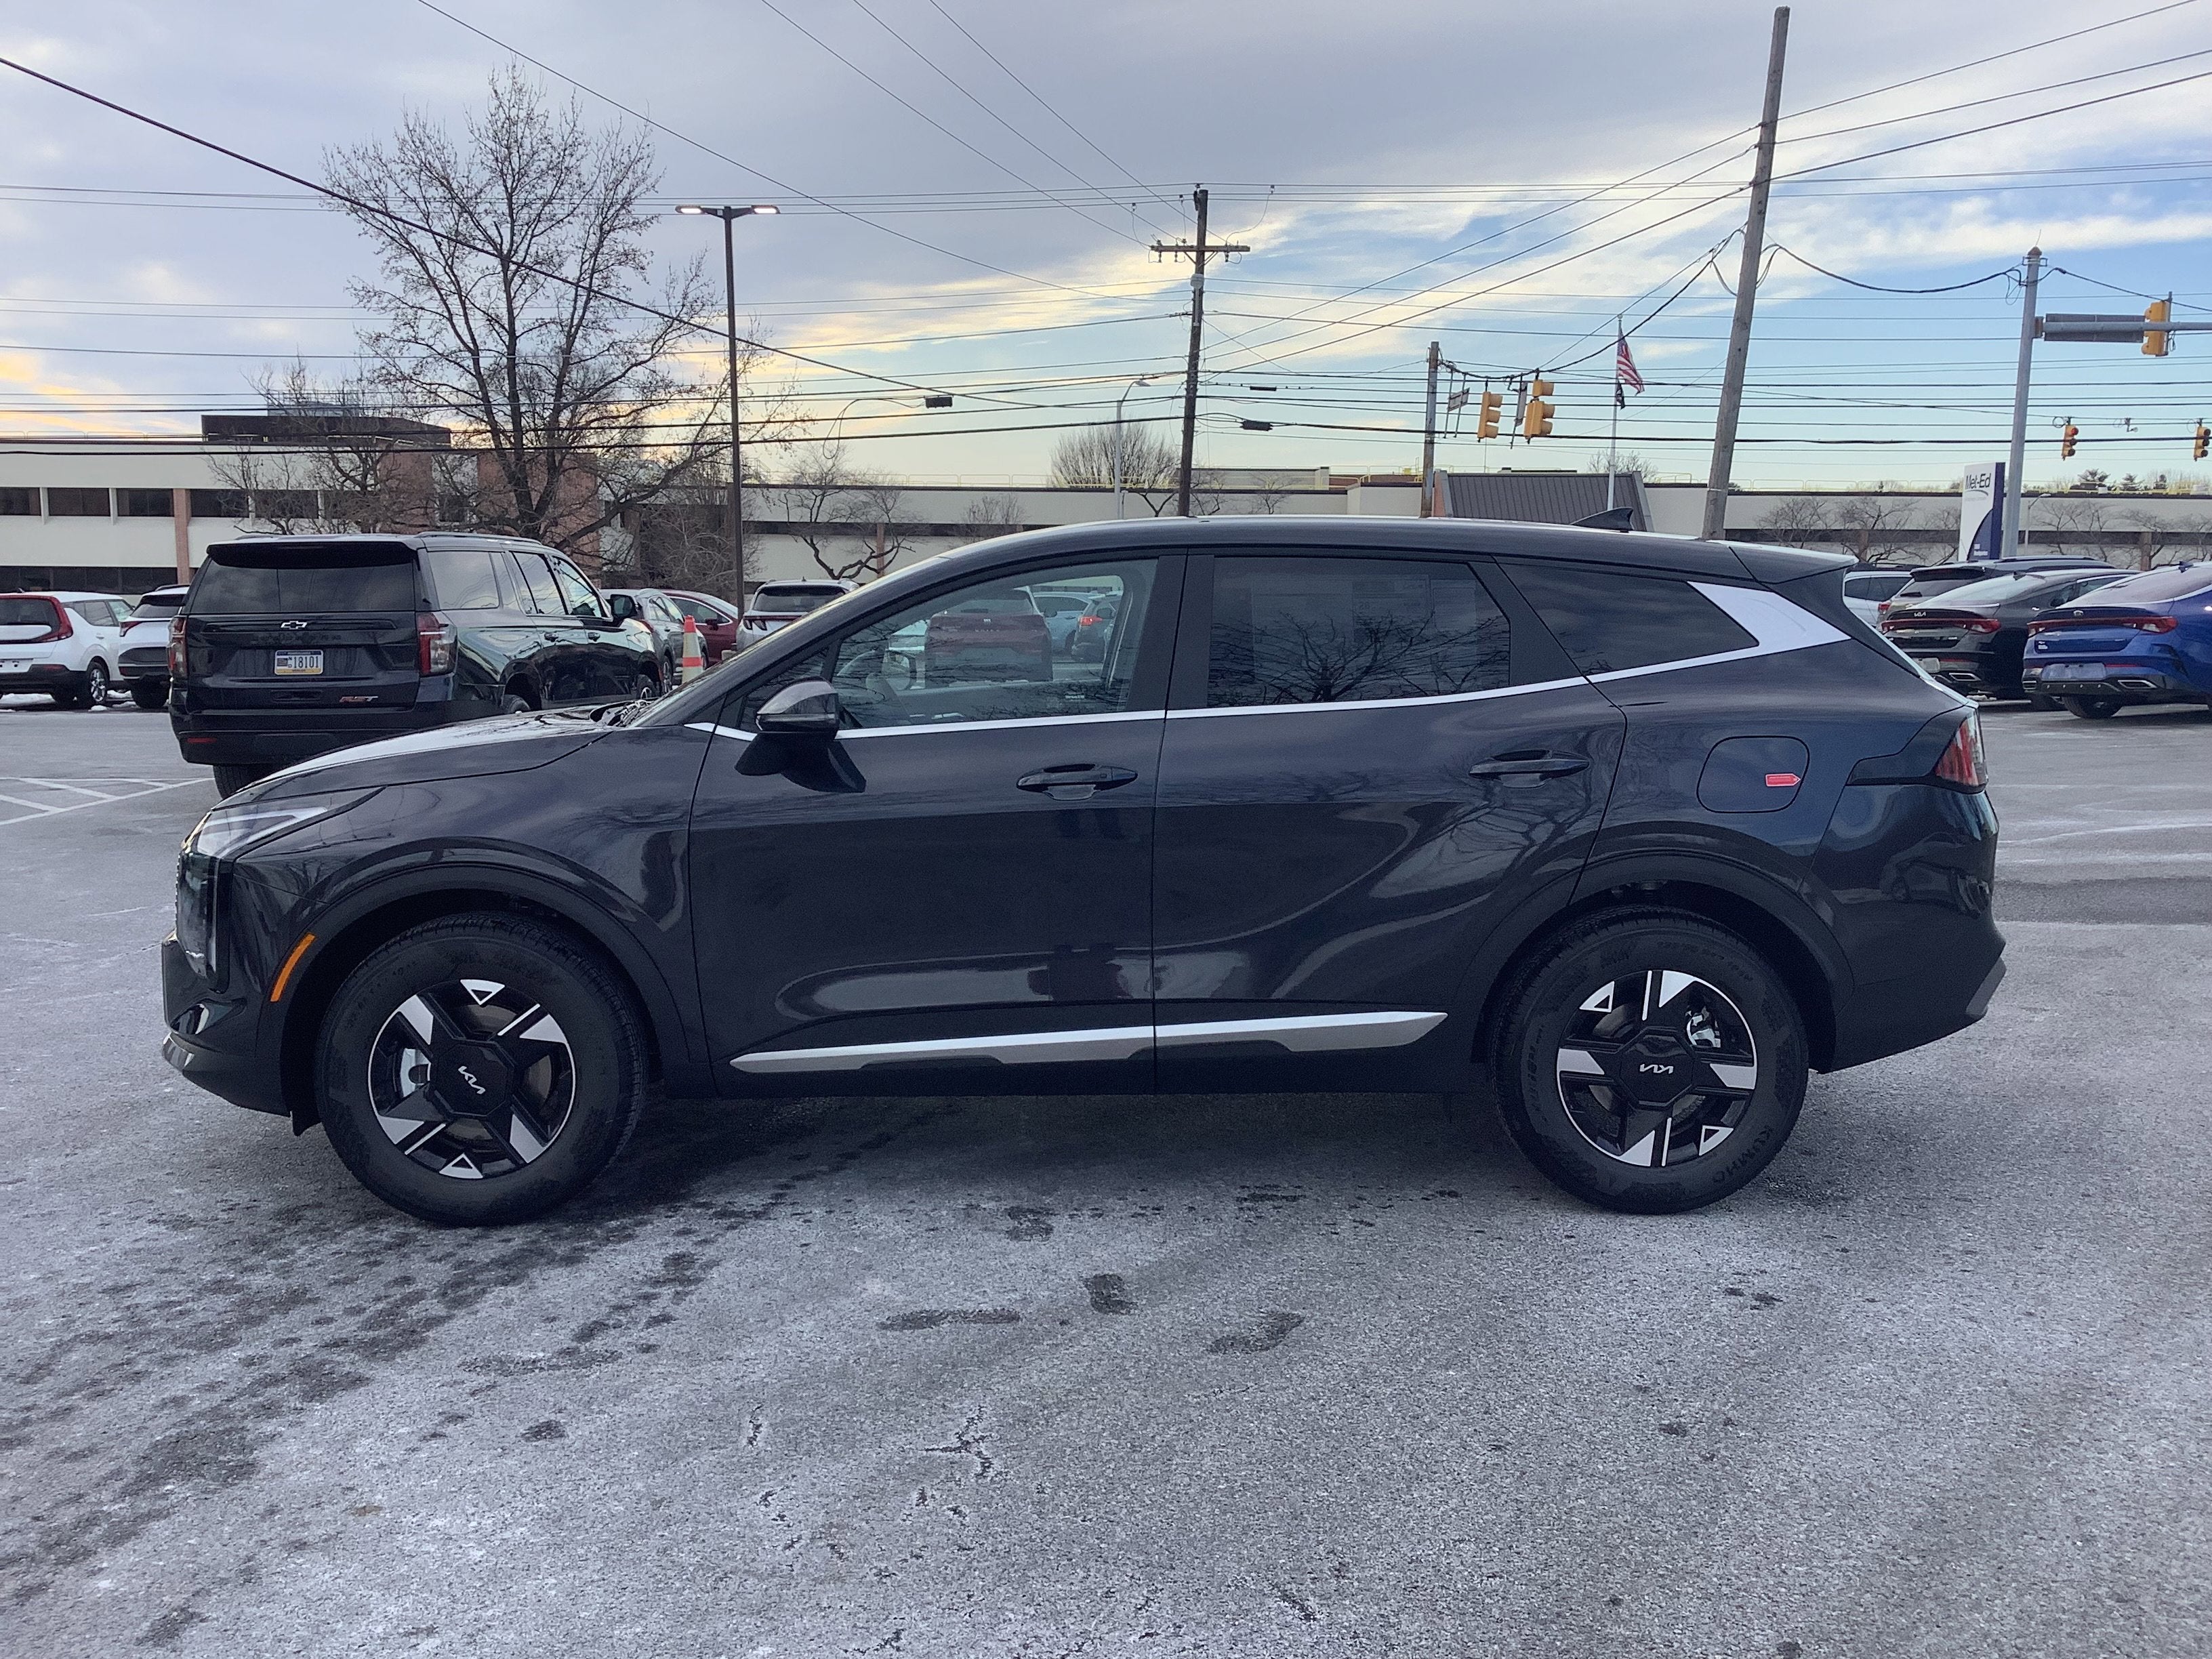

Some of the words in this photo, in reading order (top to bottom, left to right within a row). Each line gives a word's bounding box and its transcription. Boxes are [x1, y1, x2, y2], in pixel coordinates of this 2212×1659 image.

[1965, 472, 1991, 490] Met-Ed
[293, 655, 319, 668] 18101
[1639, 1063, 1674, 1074] KIA
[457, 1065, 487, 1095] KIA
[1712, 1124, 1774, 1183] KUMHO
